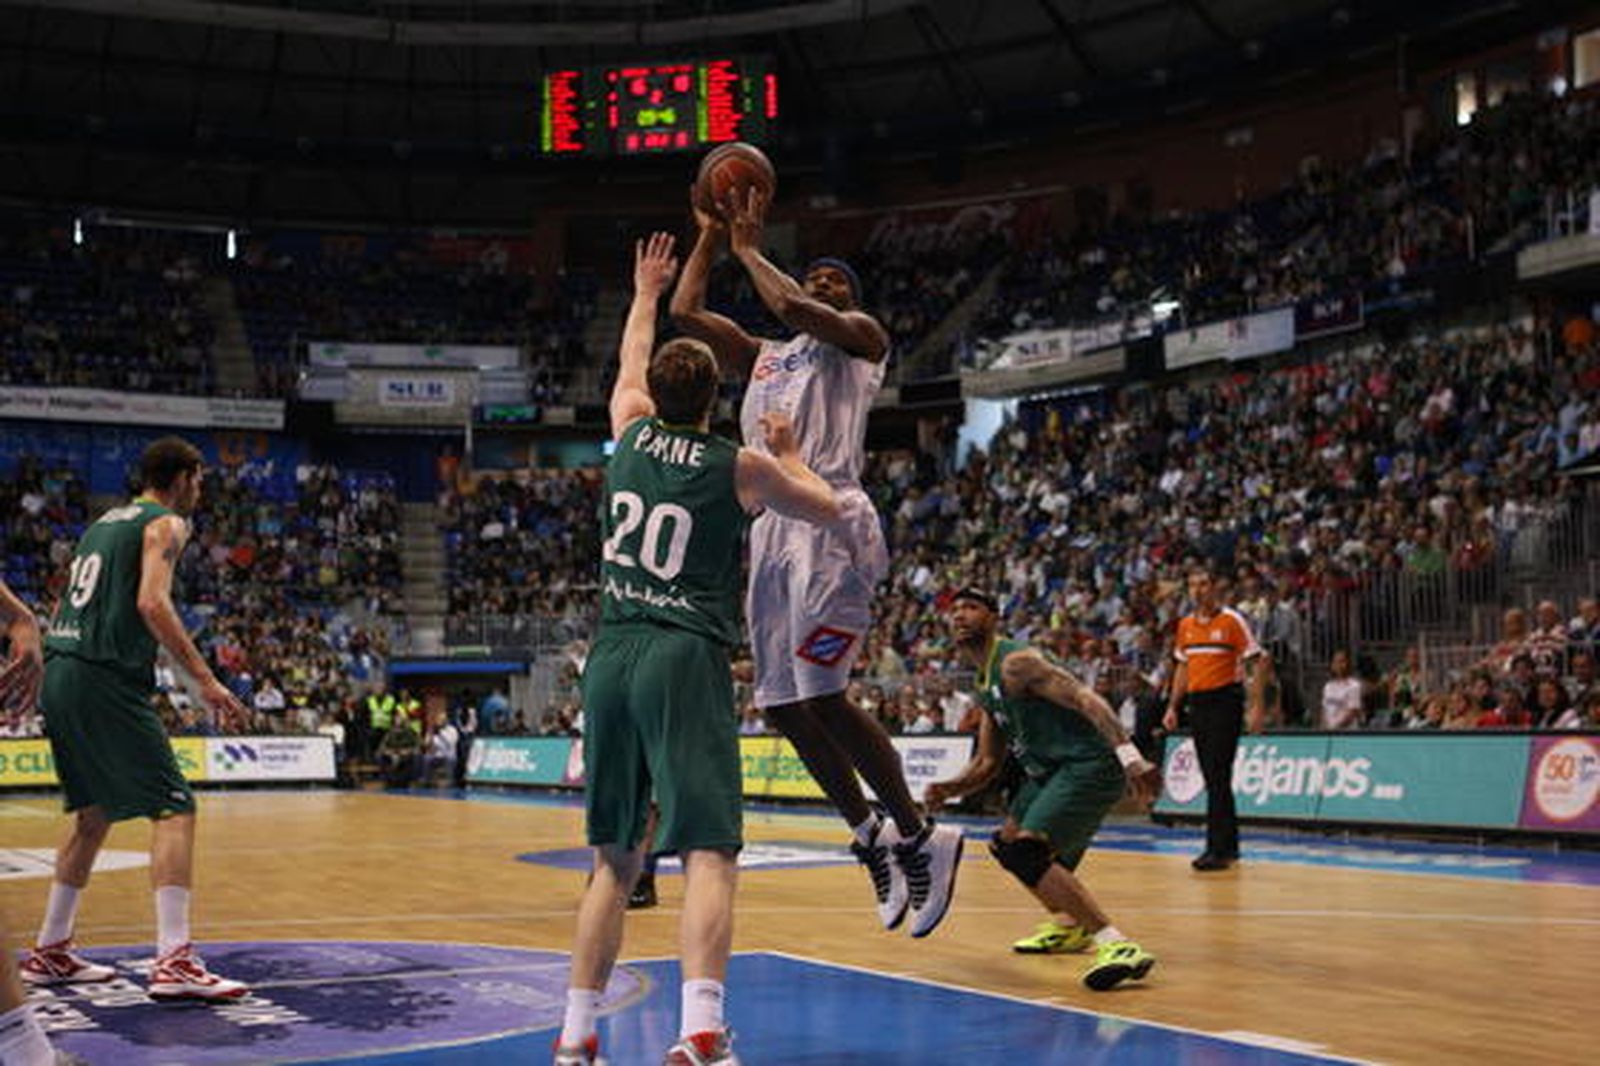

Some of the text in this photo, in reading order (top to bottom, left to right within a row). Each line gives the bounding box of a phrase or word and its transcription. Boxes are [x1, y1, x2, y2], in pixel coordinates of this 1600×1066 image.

[602, 490, 693, 582] 20
[68, 552, 102, 608] 19
[1547, 752, 1576, 781] 50
